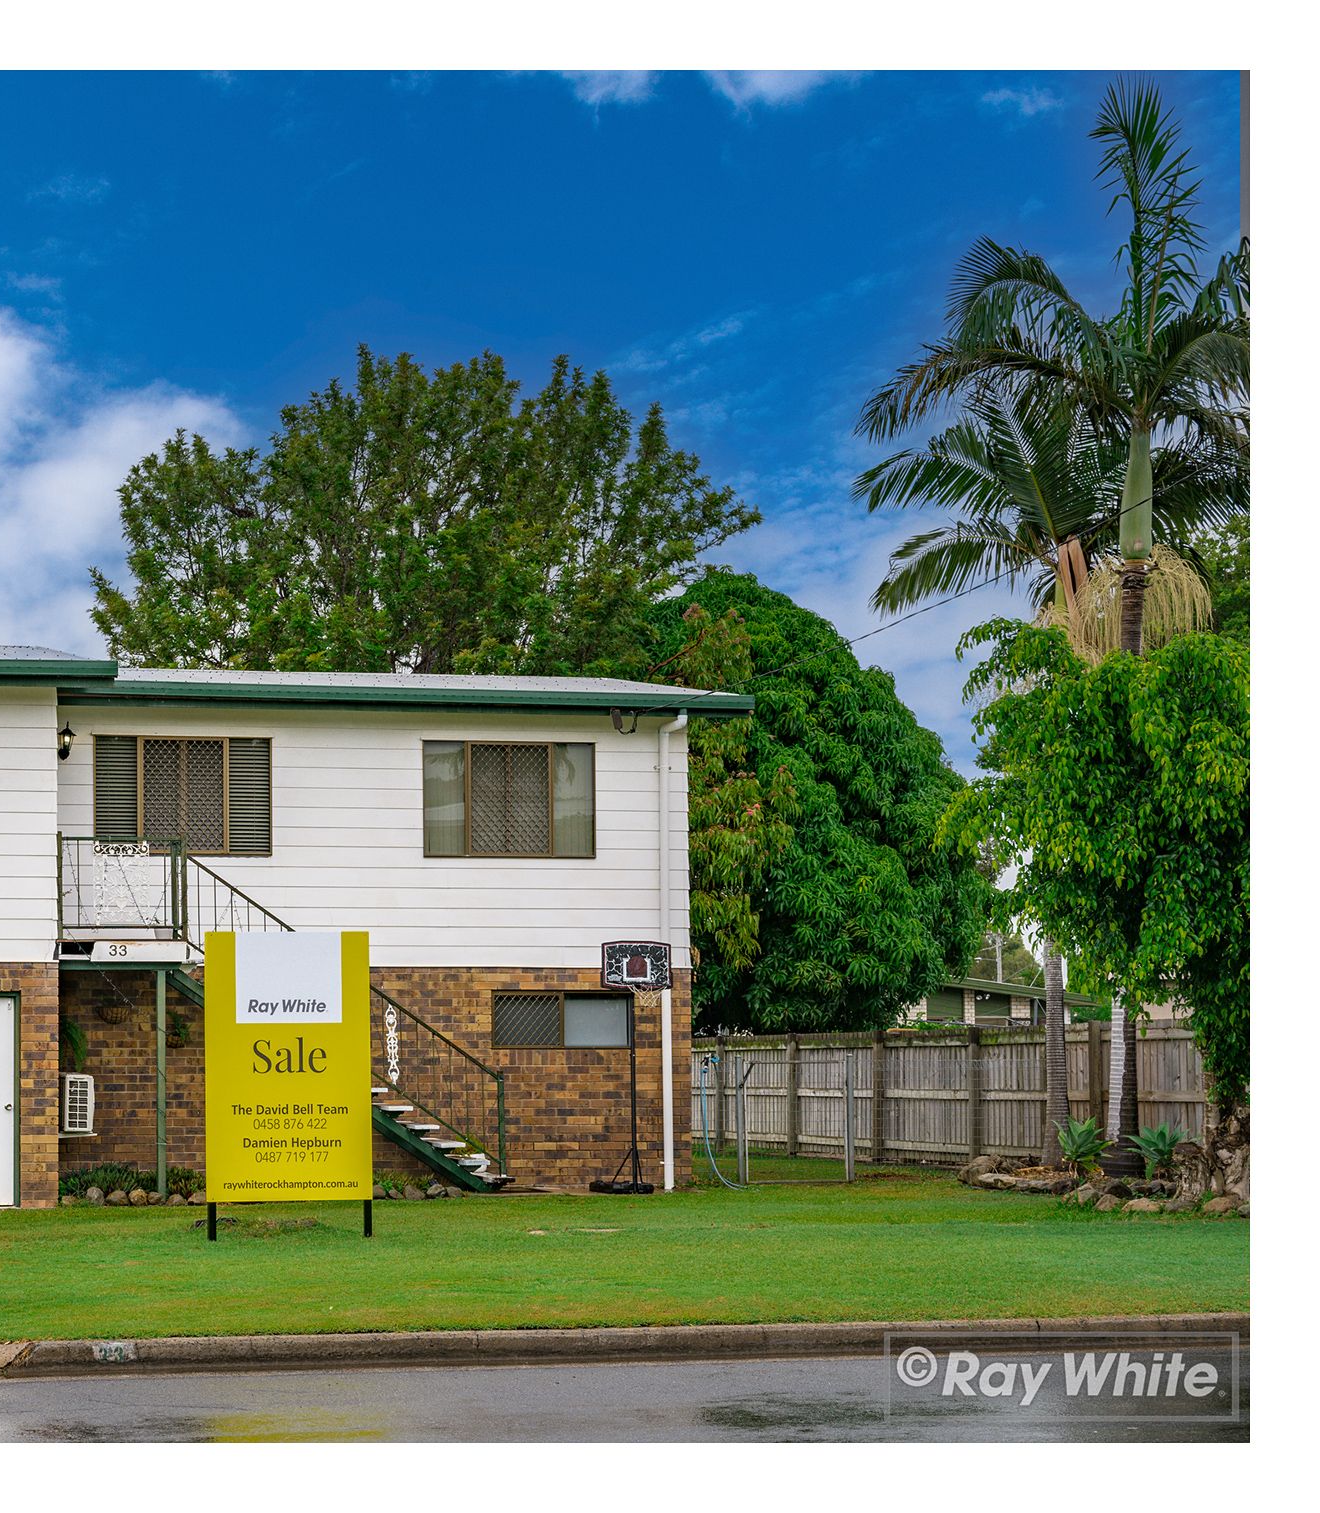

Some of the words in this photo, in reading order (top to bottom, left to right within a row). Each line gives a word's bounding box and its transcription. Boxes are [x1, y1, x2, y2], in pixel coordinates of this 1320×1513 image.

[108, 944, 128, 957] 33
[248, 999, 279, 1015] Ray
[282, 999, 327, 1013] White
[252, 1036, 327, 1074] Sale
[231, 1104, 253, 1115] The
[256, 1104, 289, 1115] David
[292, 1104, 314, 1115] Bell
[317, 1104, 349, 1115] Team
[253, 1118, 280, 1130] 0458
[283, 1118, 304, 1130] 876
[306, 1118, 328, 1130] 422
[243, 1138, 288, 1148] Damien
[291, 1137, 342, 1150] Hepburn
[255, 1151, 282, 1163] 0487
[285, 1151, 306, 1162] 719
[310, 1151, 329, 1162] 177
[223, 1180, 359, 1191] raywhiterockhampton.com.au
